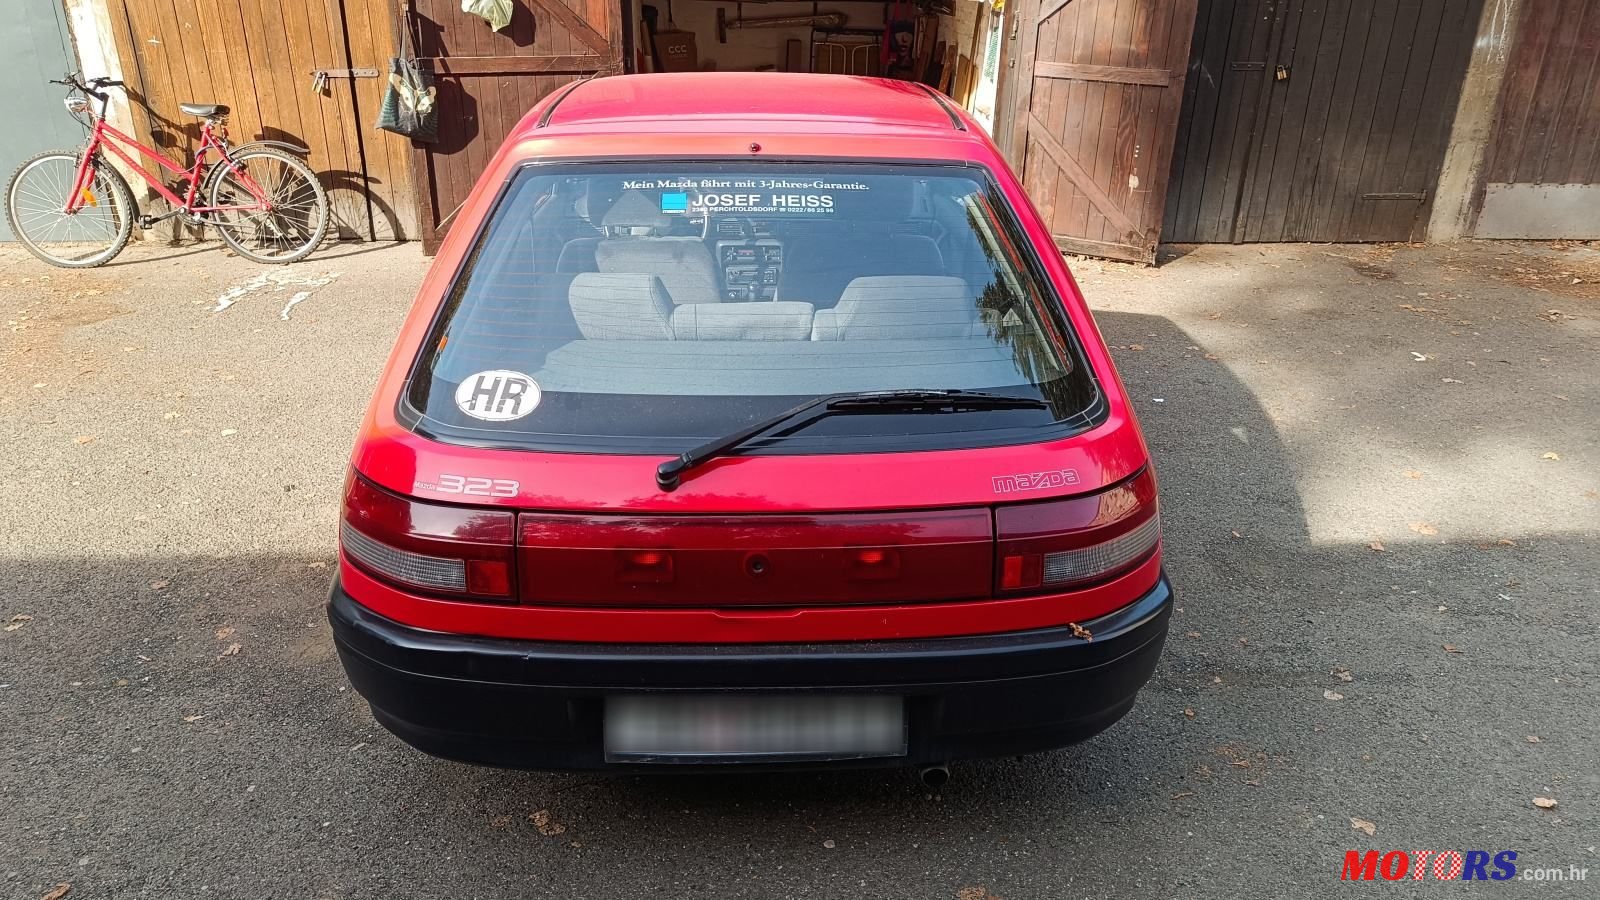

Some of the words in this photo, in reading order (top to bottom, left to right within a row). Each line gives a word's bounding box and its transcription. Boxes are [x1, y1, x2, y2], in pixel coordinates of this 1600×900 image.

[623, 181, 654, 189] Mein
[657, 180, 698, 188] Mazda
[701, 180, 731, 188] fährt
[759, 180, 870, 190] 3-Jahres-Garantie.
[692, 194, 761, 206] JOSEF
[772, 194, 834, 208] HEISS
[468, 375, 529, 415] HR
[436, 474, 520, 498] 323
